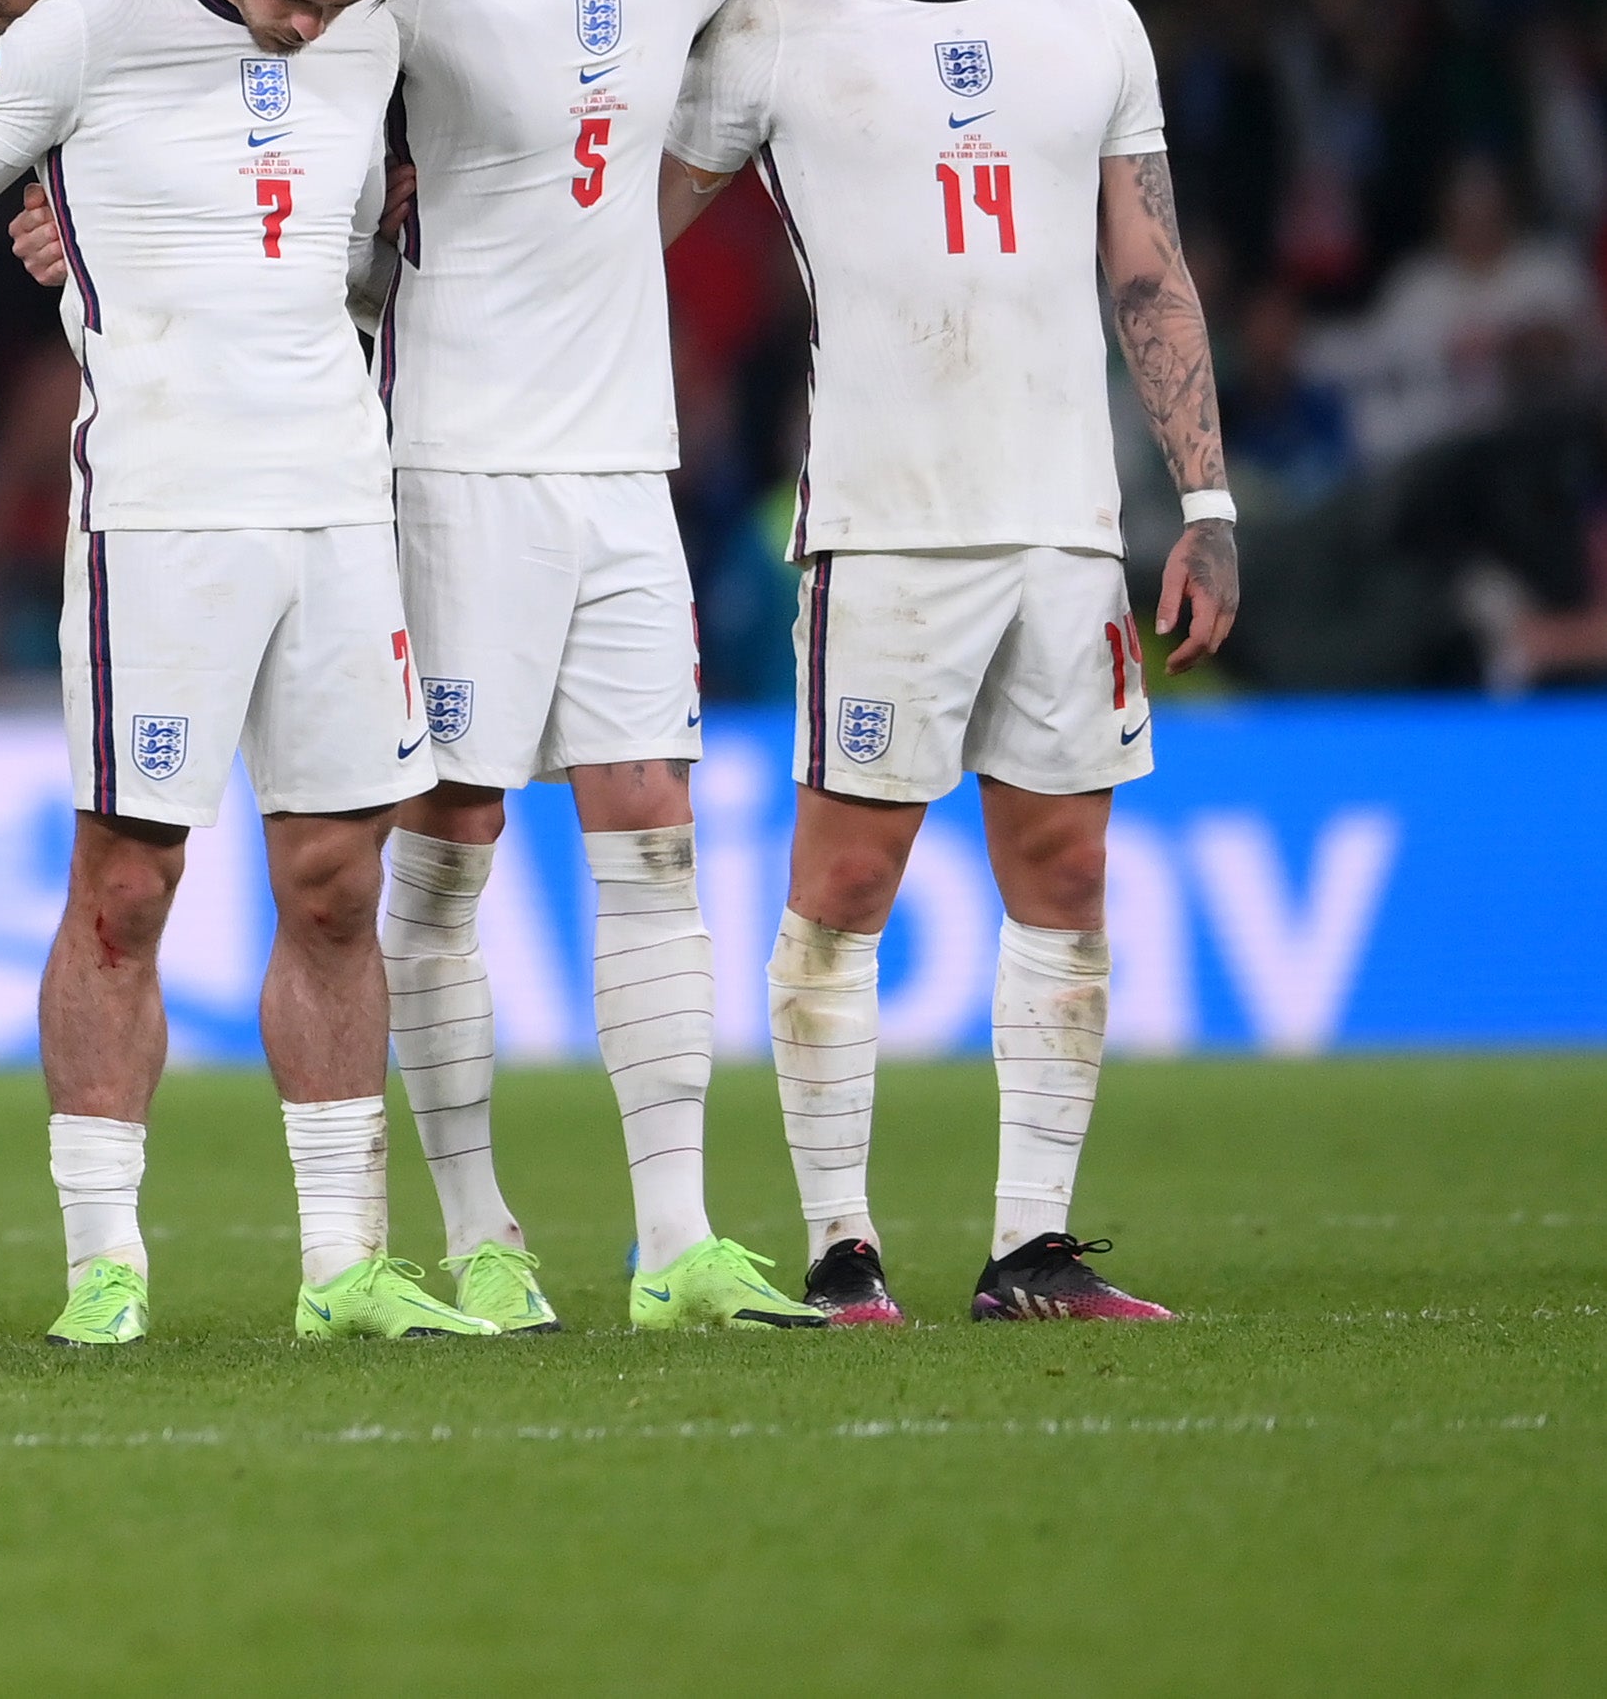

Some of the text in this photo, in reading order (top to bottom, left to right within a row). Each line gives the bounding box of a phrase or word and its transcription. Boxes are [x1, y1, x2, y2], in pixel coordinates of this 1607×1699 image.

[572, 118, 612, 208] 5
[256, 178, 294, 259] 7
[937, 163, 1018, 255] 14
